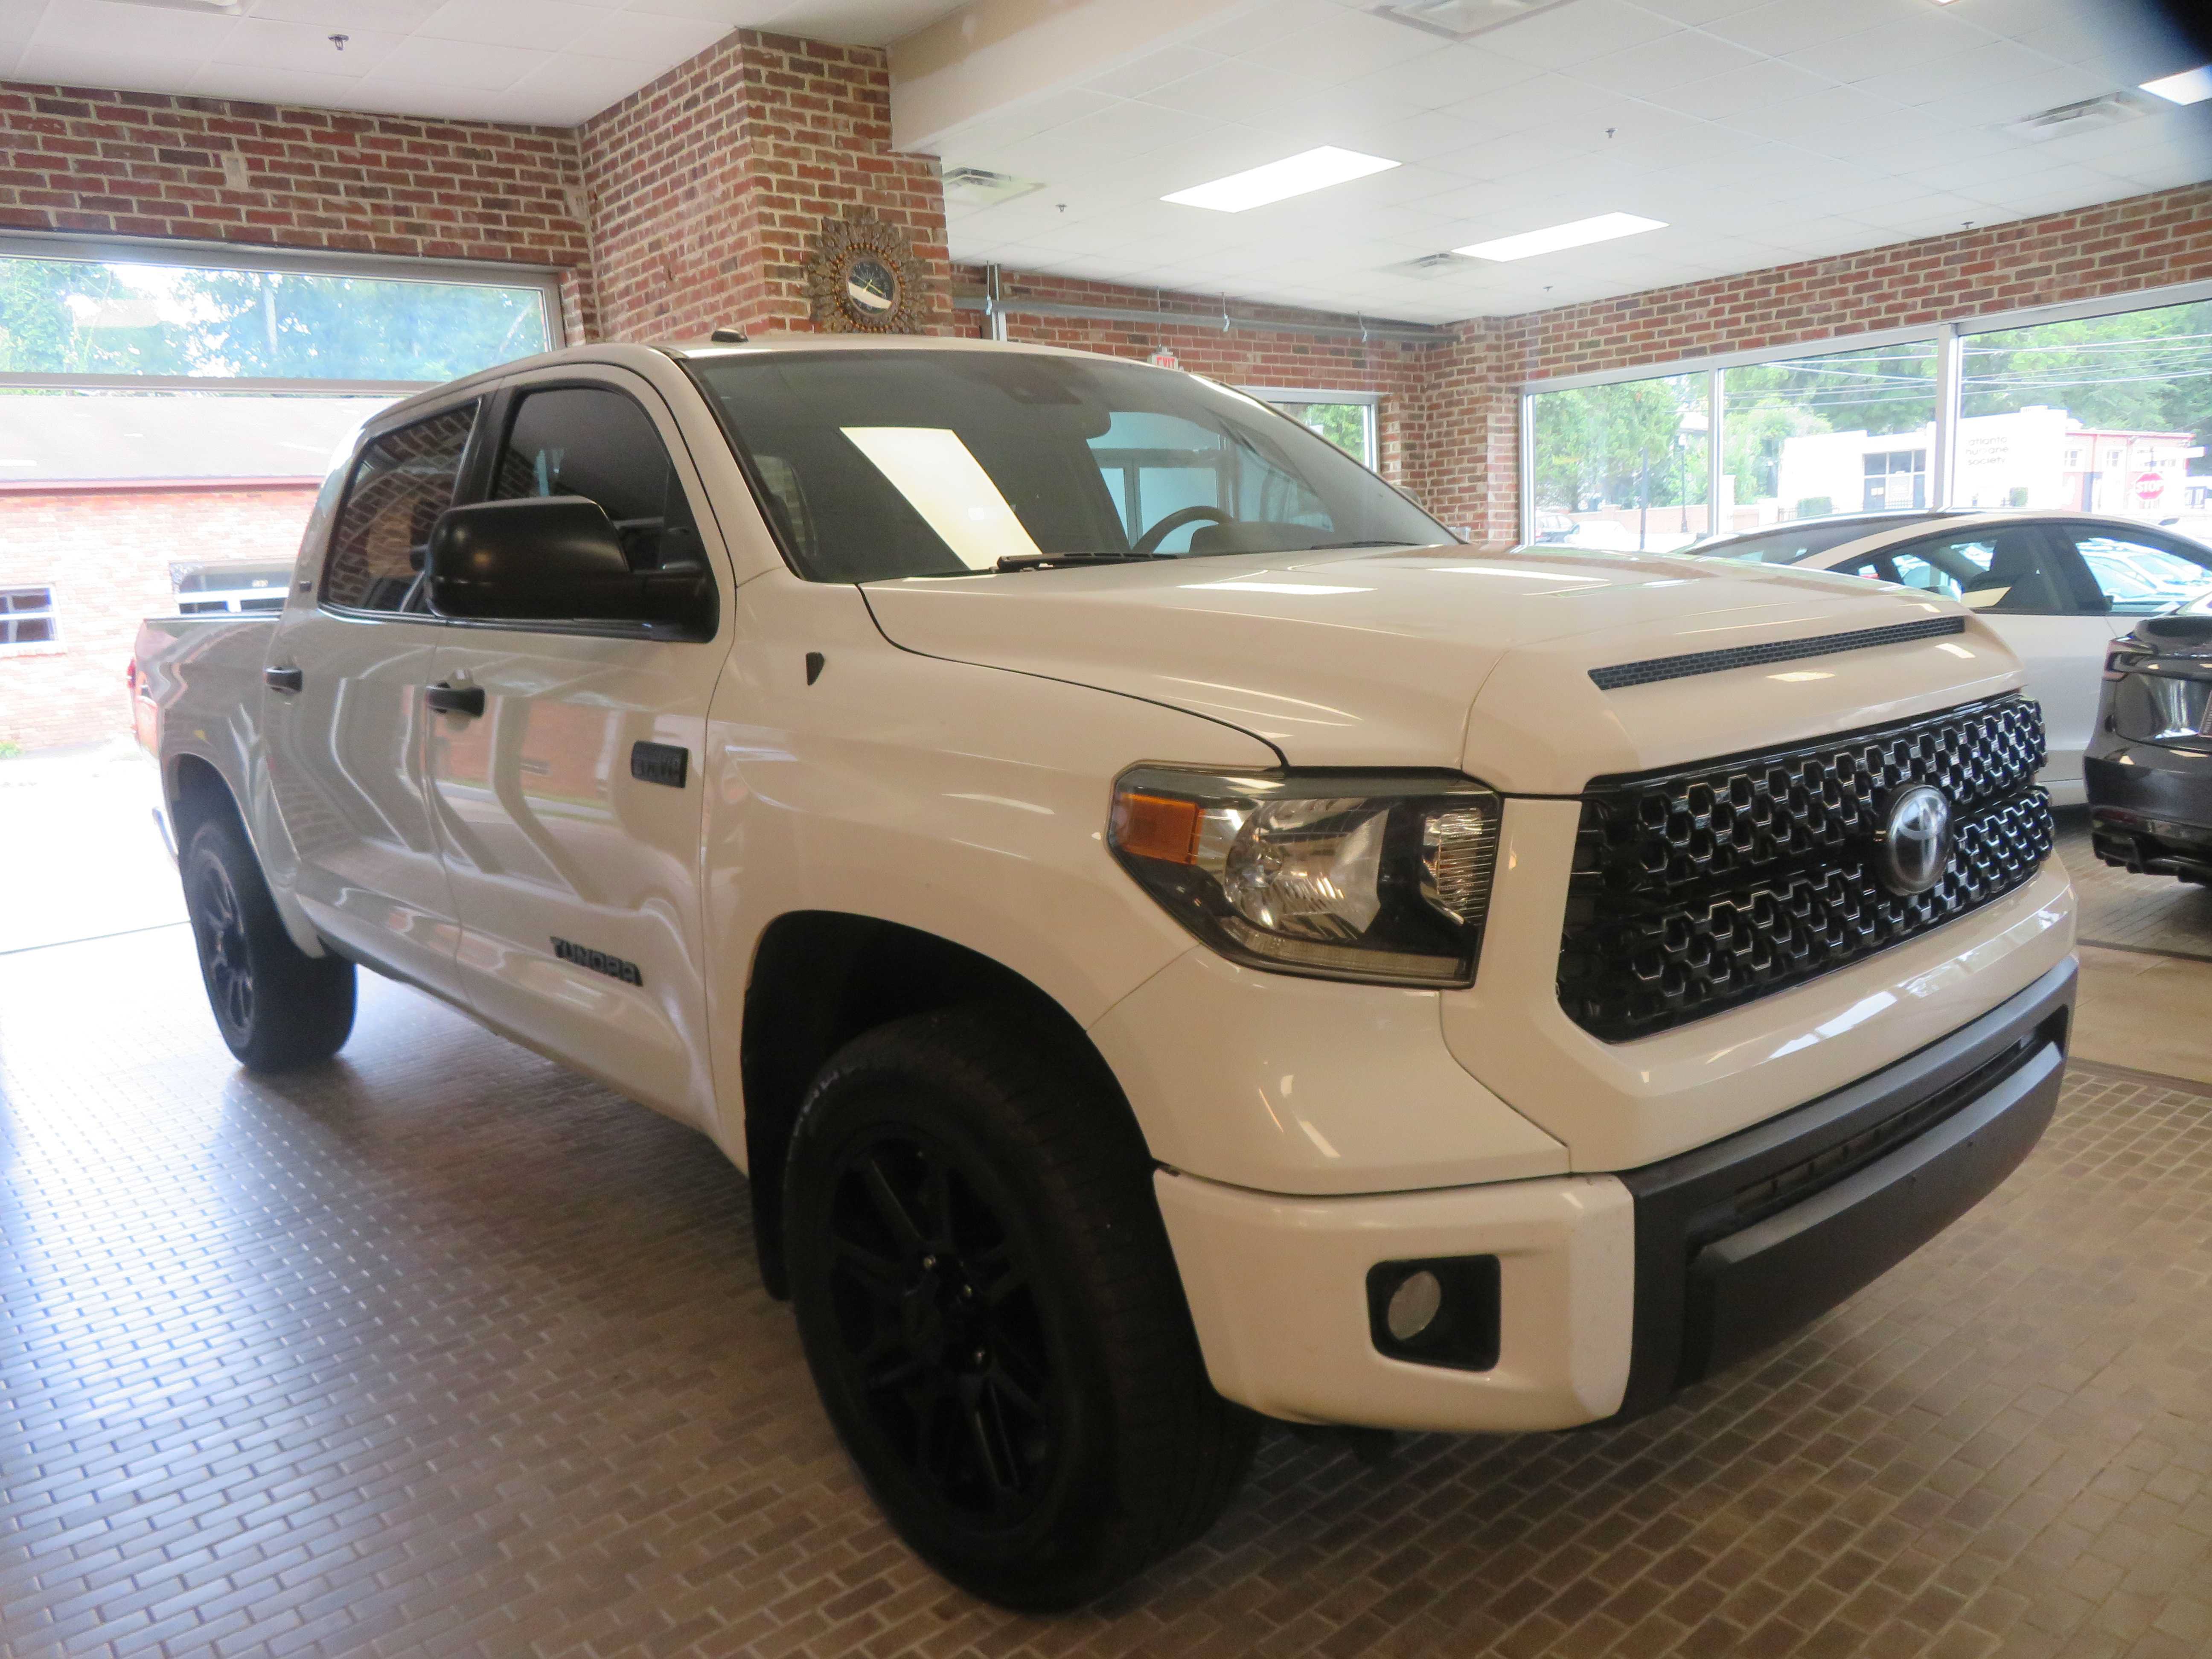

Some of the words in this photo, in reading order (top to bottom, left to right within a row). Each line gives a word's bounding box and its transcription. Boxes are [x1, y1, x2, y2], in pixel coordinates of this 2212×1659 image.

[1156, 355, 1175, 369] EXIT
[2136, 480, 2164, 494] STOP
[550, 936, 643, 987] TUNDRA
